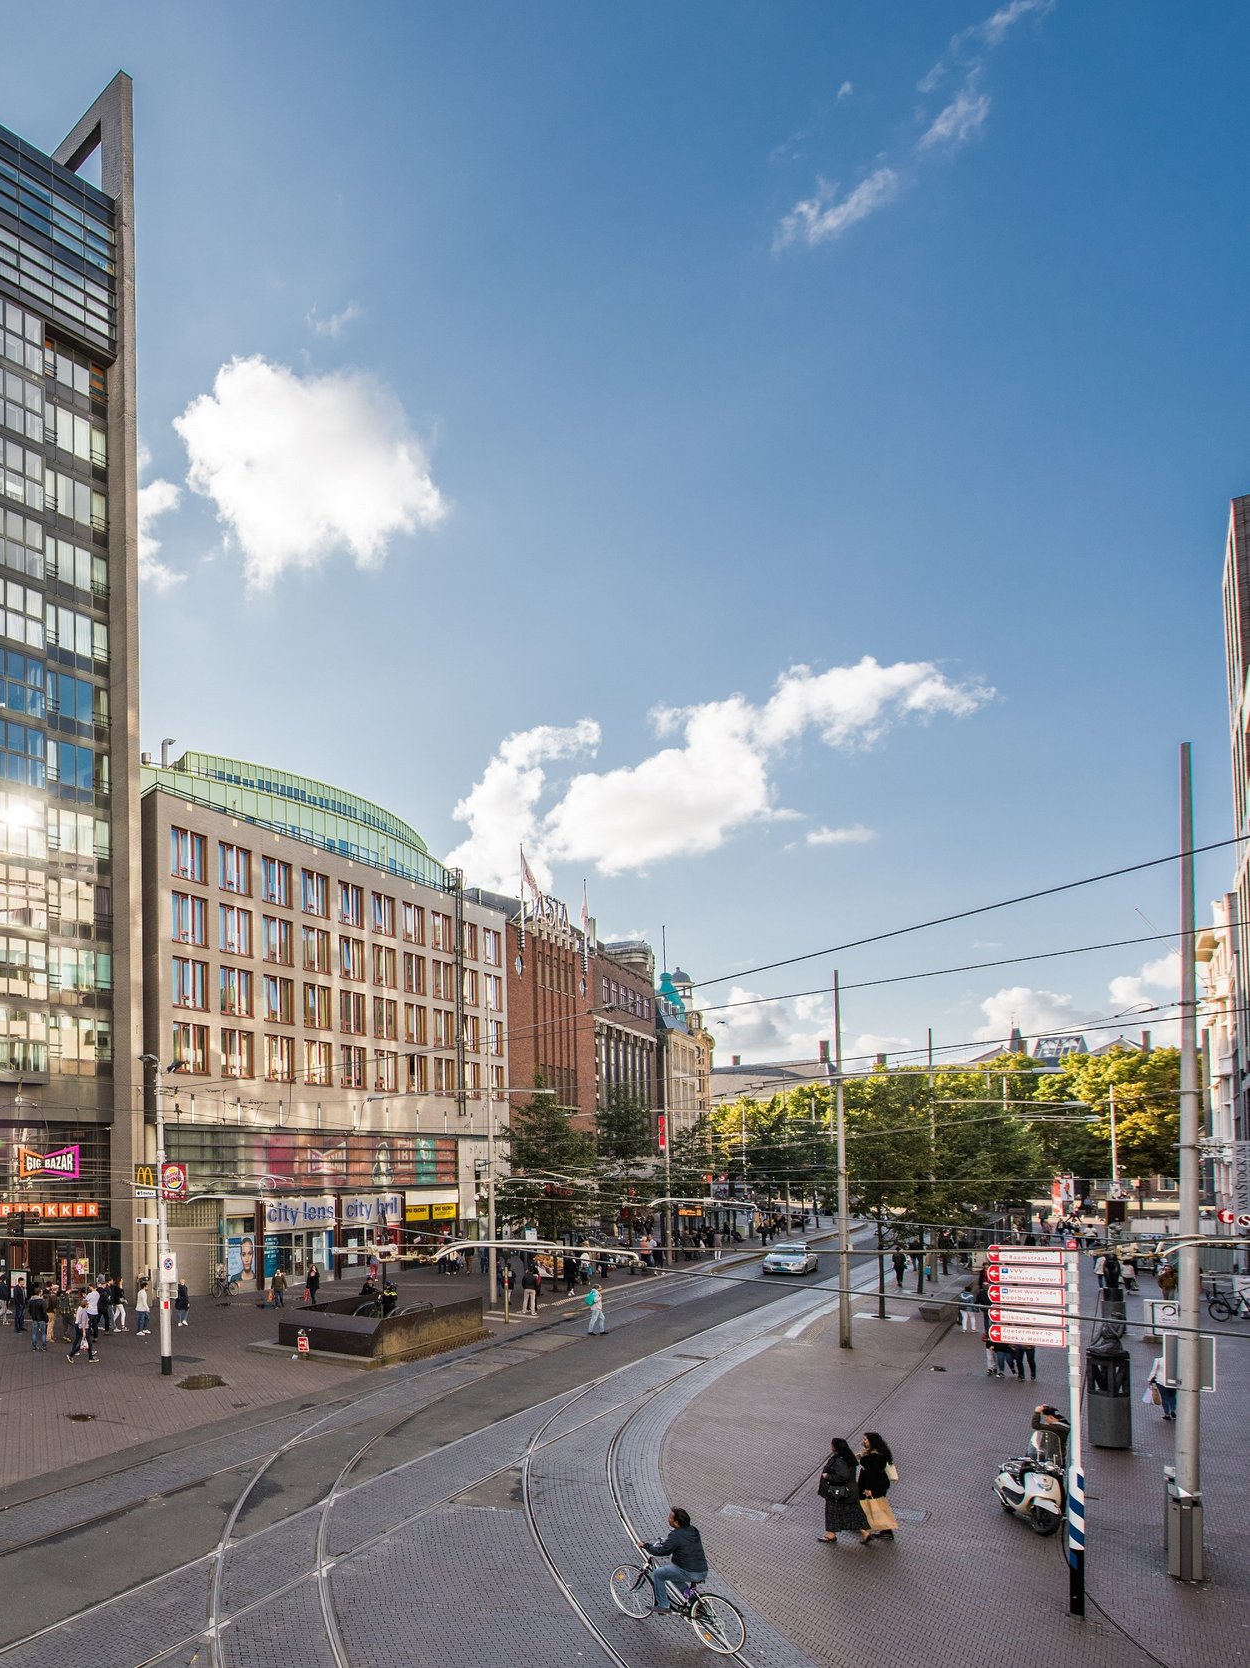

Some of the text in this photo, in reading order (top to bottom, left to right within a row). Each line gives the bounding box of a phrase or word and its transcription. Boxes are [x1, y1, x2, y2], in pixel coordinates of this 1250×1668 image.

[26, 1154, 74, 1171] BIG BAZAR
[346, 1196, 398, 1220] city bril
[1237, 1193, 1248, 1211] VAN
[267, 1201, 335, 1226] city lens
